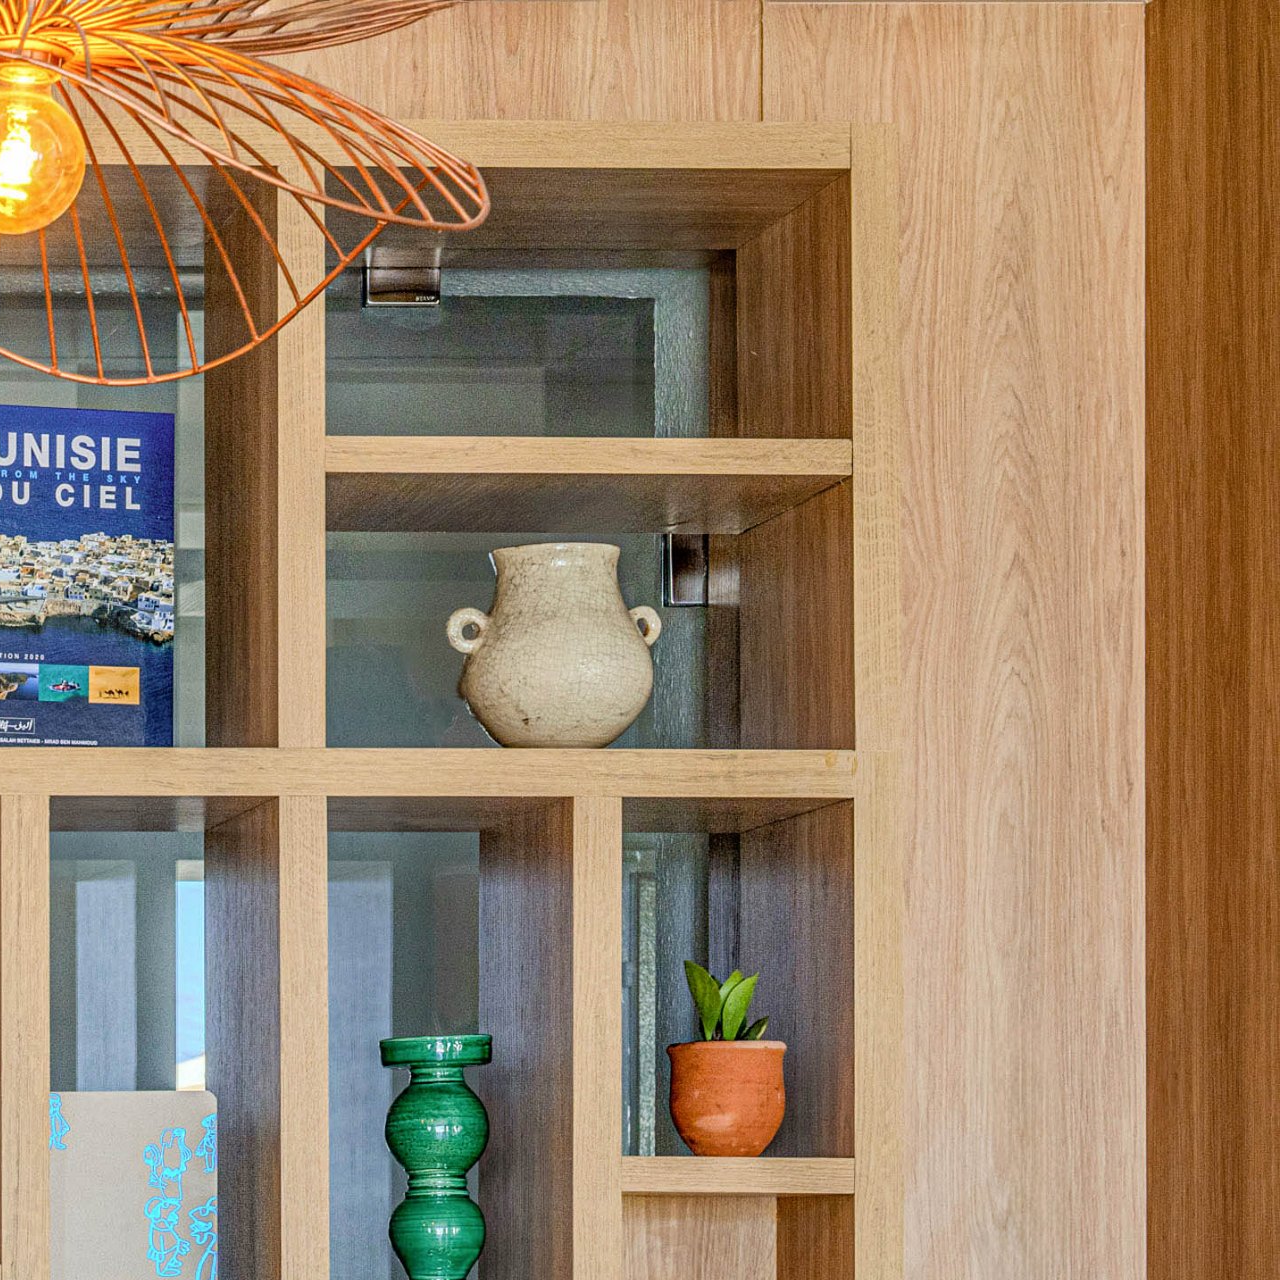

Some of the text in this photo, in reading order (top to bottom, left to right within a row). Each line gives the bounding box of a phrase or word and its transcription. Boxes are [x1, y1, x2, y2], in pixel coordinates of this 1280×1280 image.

[55, 471, 90, 482] THE
[106, 474, 142, 485] SKY
[55, 483, 141, 511] CIEL
